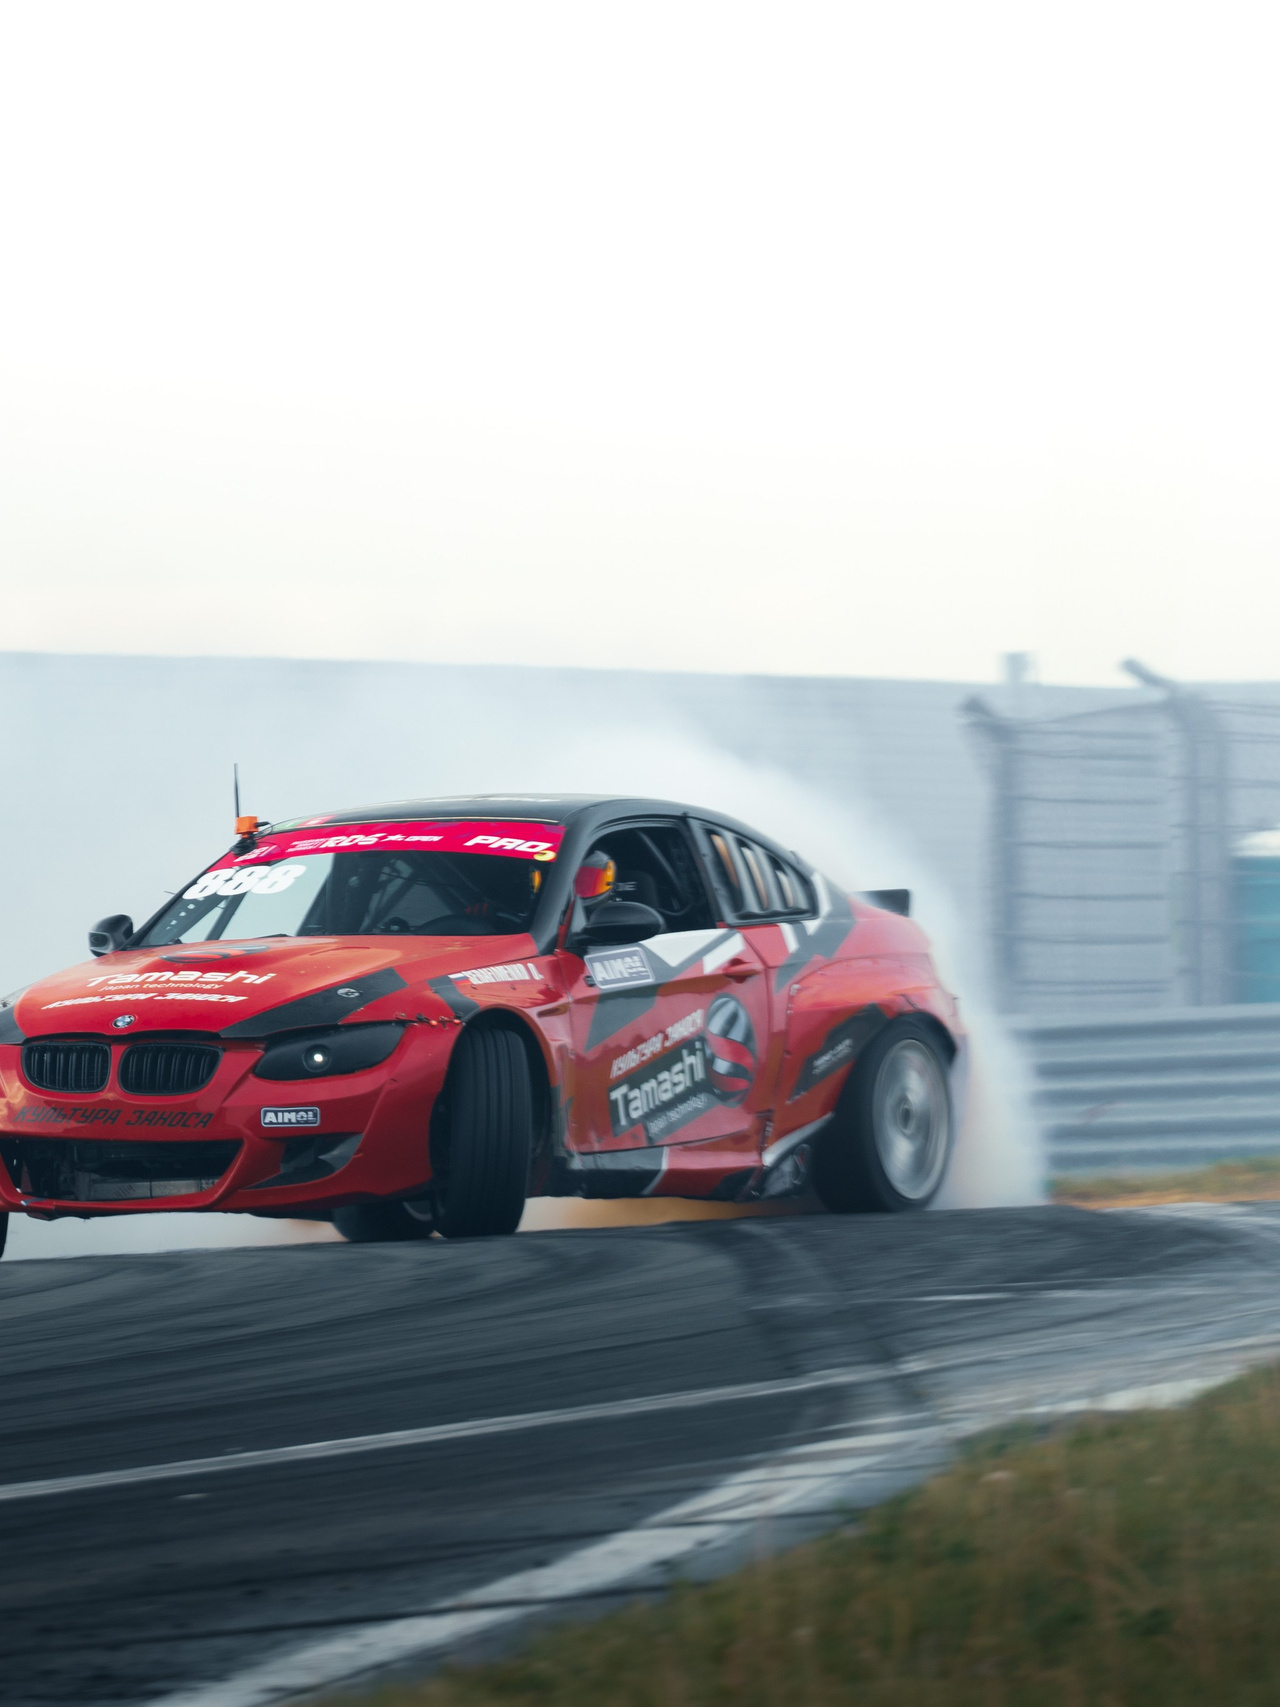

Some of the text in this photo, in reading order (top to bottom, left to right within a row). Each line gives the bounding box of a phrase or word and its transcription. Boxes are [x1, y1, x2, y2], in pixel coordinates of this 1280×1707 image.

[320, 832, 387, 849] RDS
[464, 834, 553, 853] PRO
[183, 864, 306, 899] 888
[86, 971, 277, 987] Tamashi
[143, 982, 224, 991] technology
[609, 1041, 707, 1126] Tamashi
[14, 1106, 214, 1128] КУЛЬТУРА ЗАНОСА
[263, 1110, 318, 1124] AIMOL
